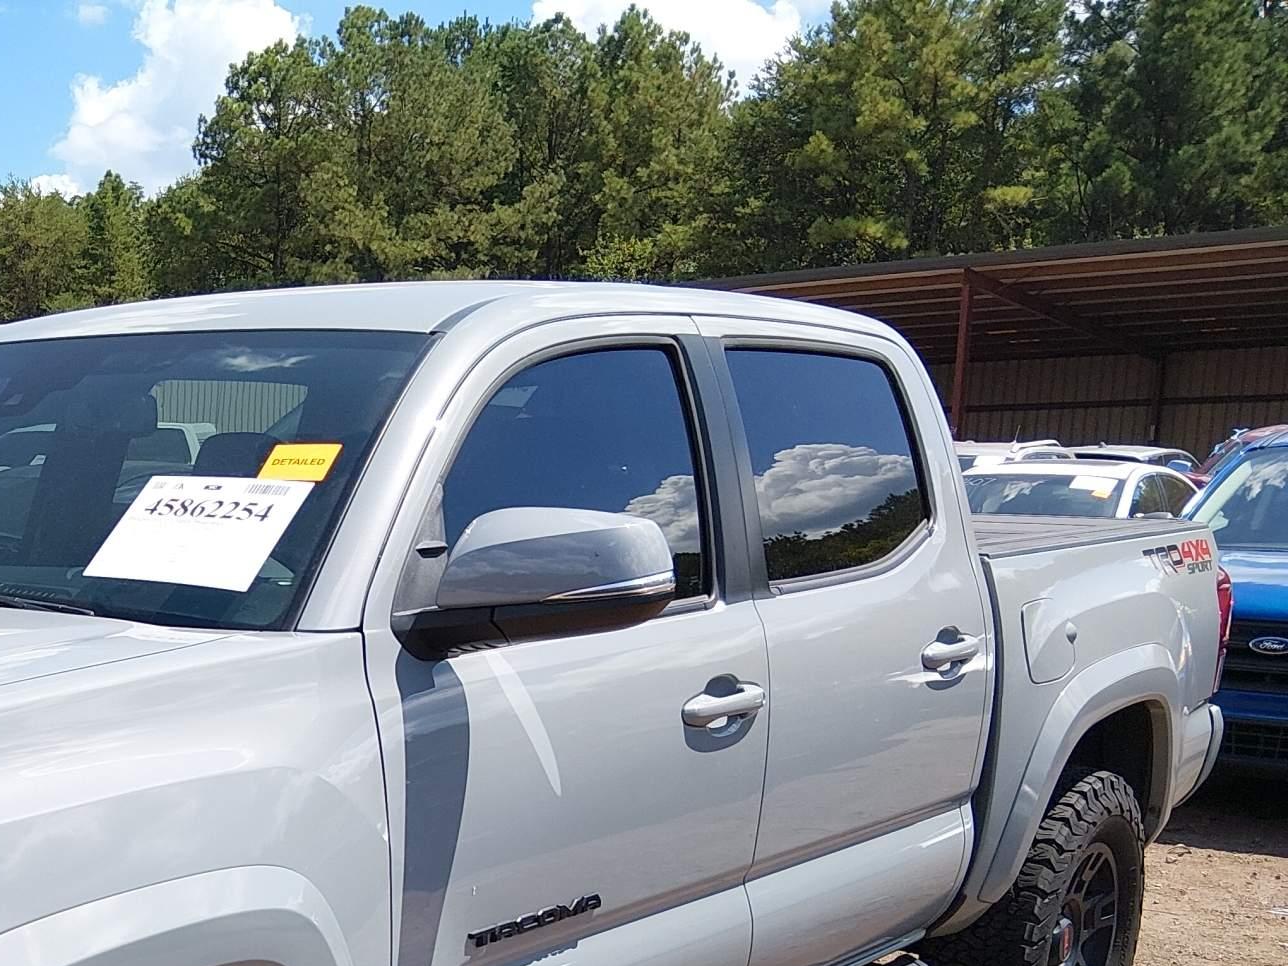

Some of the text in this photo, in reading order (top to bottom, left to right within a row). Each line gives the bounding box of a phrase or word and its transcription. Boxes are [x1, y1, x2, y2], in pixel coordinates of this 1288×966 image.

[271, 457, 326, 467] DETAILED
[144, 498, 275, 523] 45862254
[1142, 539, 1212, 577] TRD 4X4
[1187, 560, 1213, 575] SPORT
[467, 892, 602, 948] TACOMA
